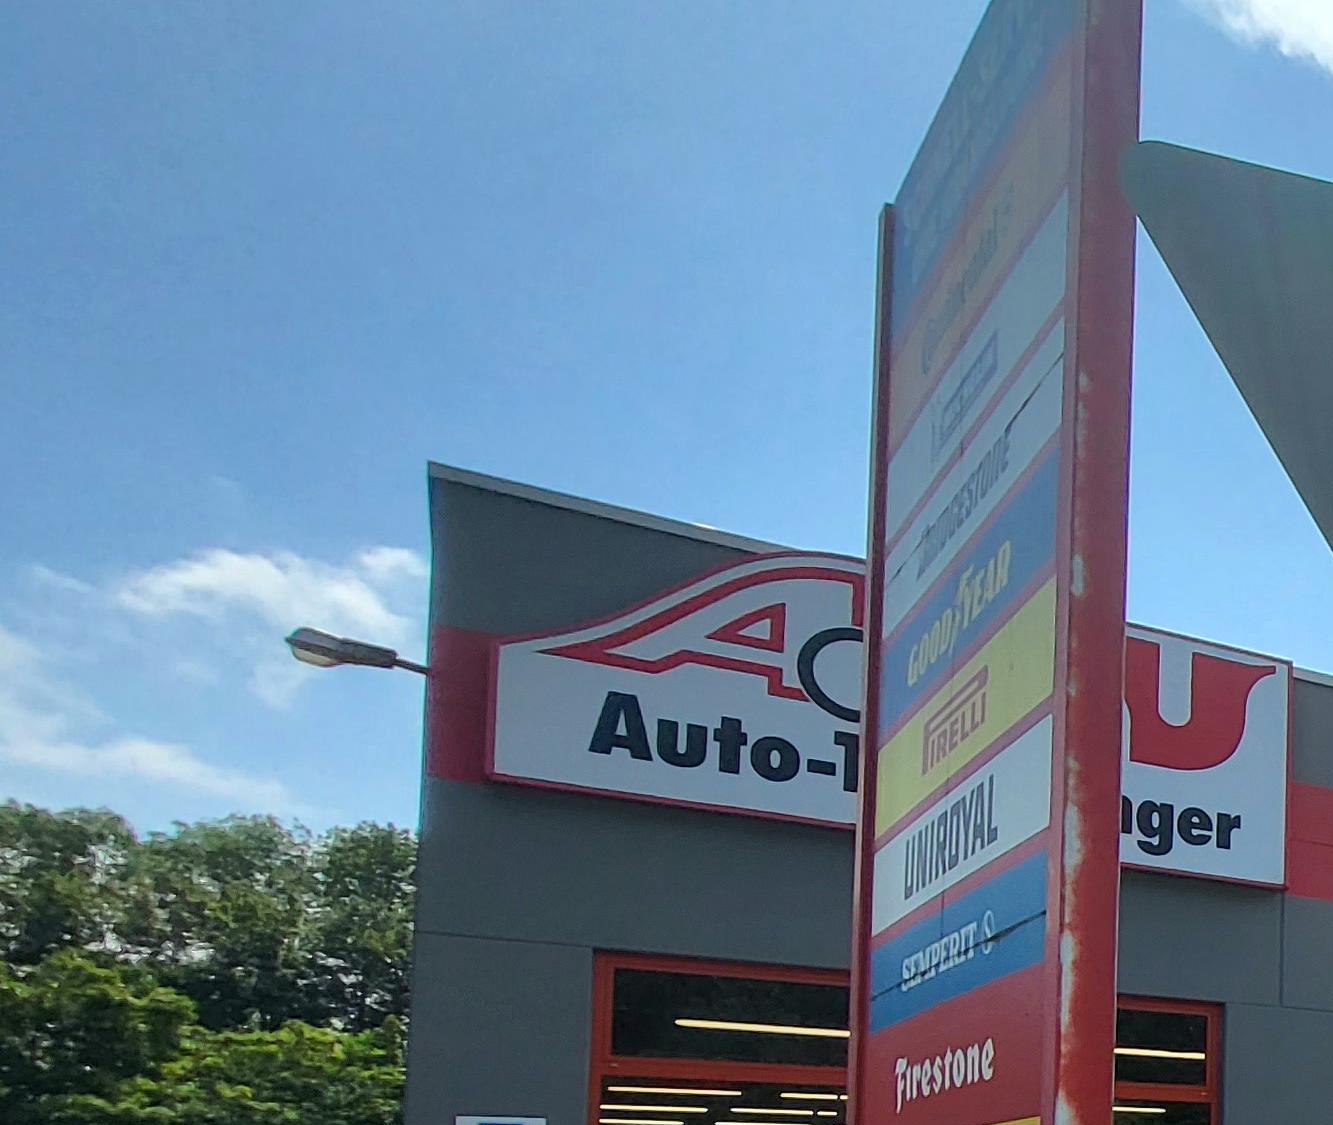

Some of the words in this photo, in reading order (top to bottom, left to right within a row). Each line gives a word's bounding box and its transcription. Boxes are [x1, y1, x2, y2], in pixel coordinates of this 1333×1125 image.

[907, 539, 1012, 686] GOODYEAR
[921, 665, 988, 776] PIRELLI
[903, 773, 998, 901] UNIROYAL
[901, 920, 978, 993] SEMPERIT
[895, 1037, 995, 1114] Firestone
